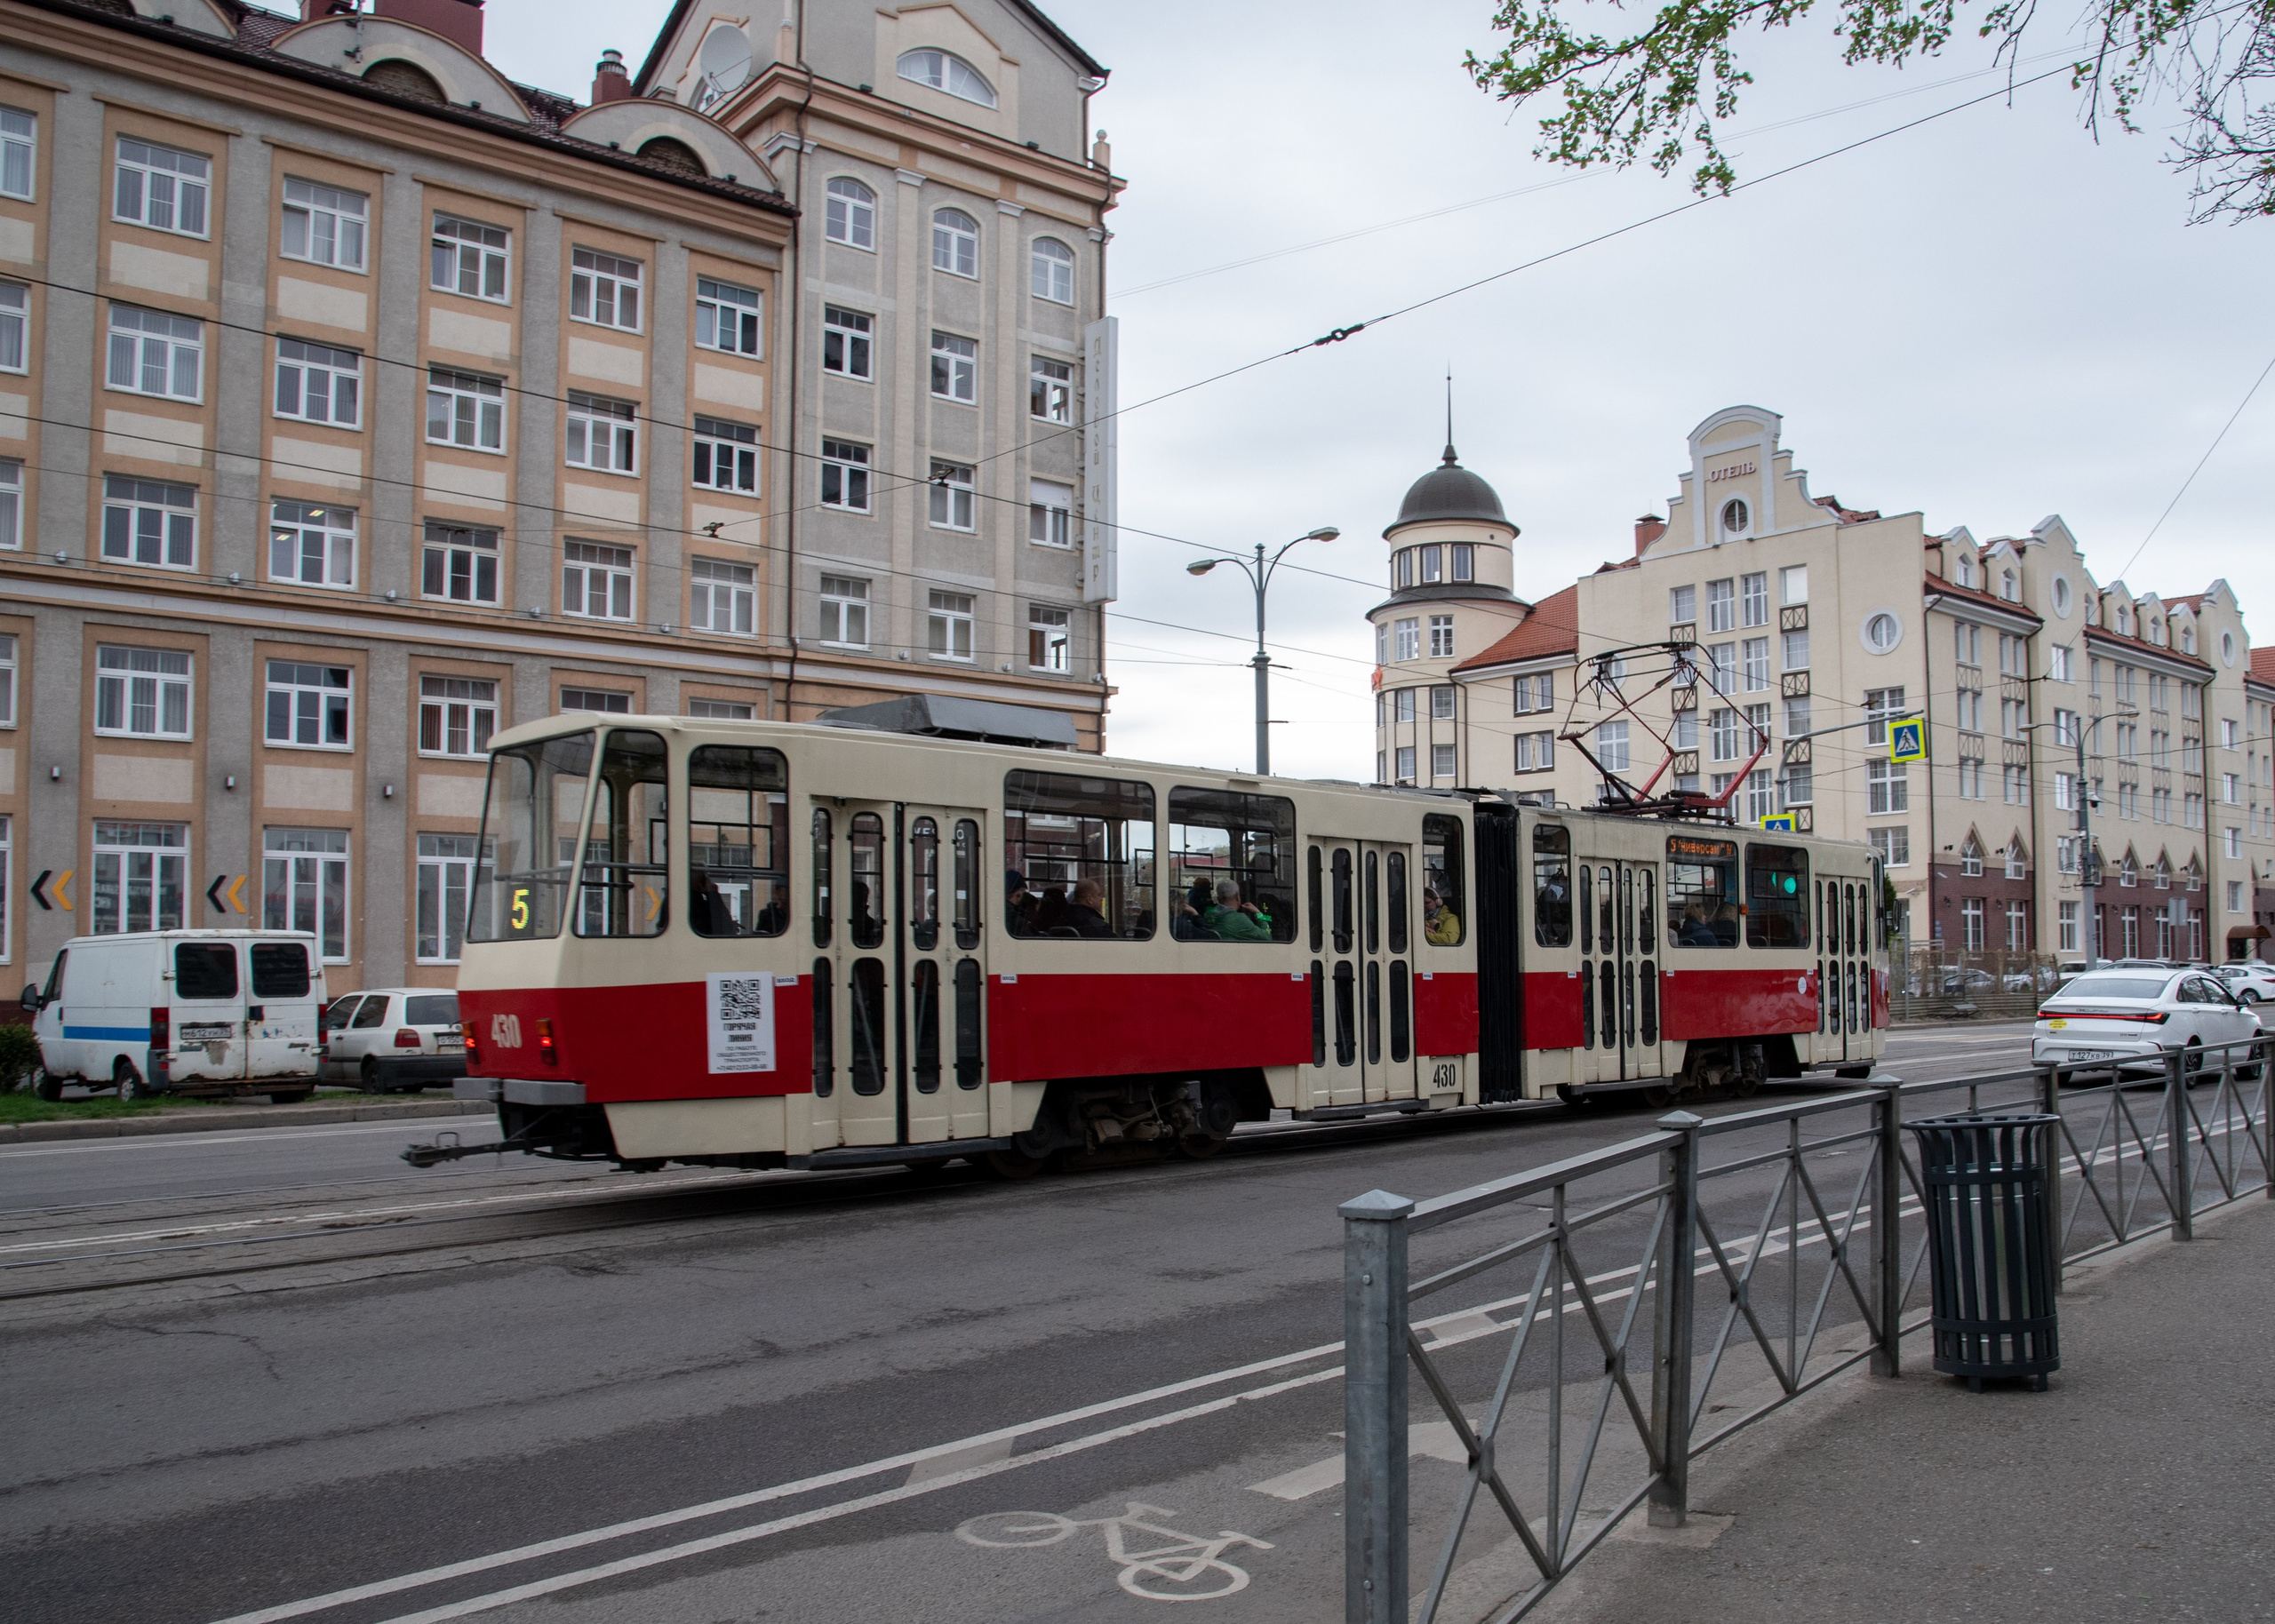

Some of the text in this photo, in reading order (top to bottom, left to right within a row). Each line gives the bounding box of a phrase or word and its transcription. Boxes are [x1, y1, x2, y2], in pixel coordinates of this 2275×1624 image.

[1708, 461, 1757, 482] ОТЕЛЬ
[1670, 839, 1676, 853] 5
[511, 888, 530, 929] 5
[491, 1014, 523, 1048] 430
[1433, 1063, 1457, 1088] 430
